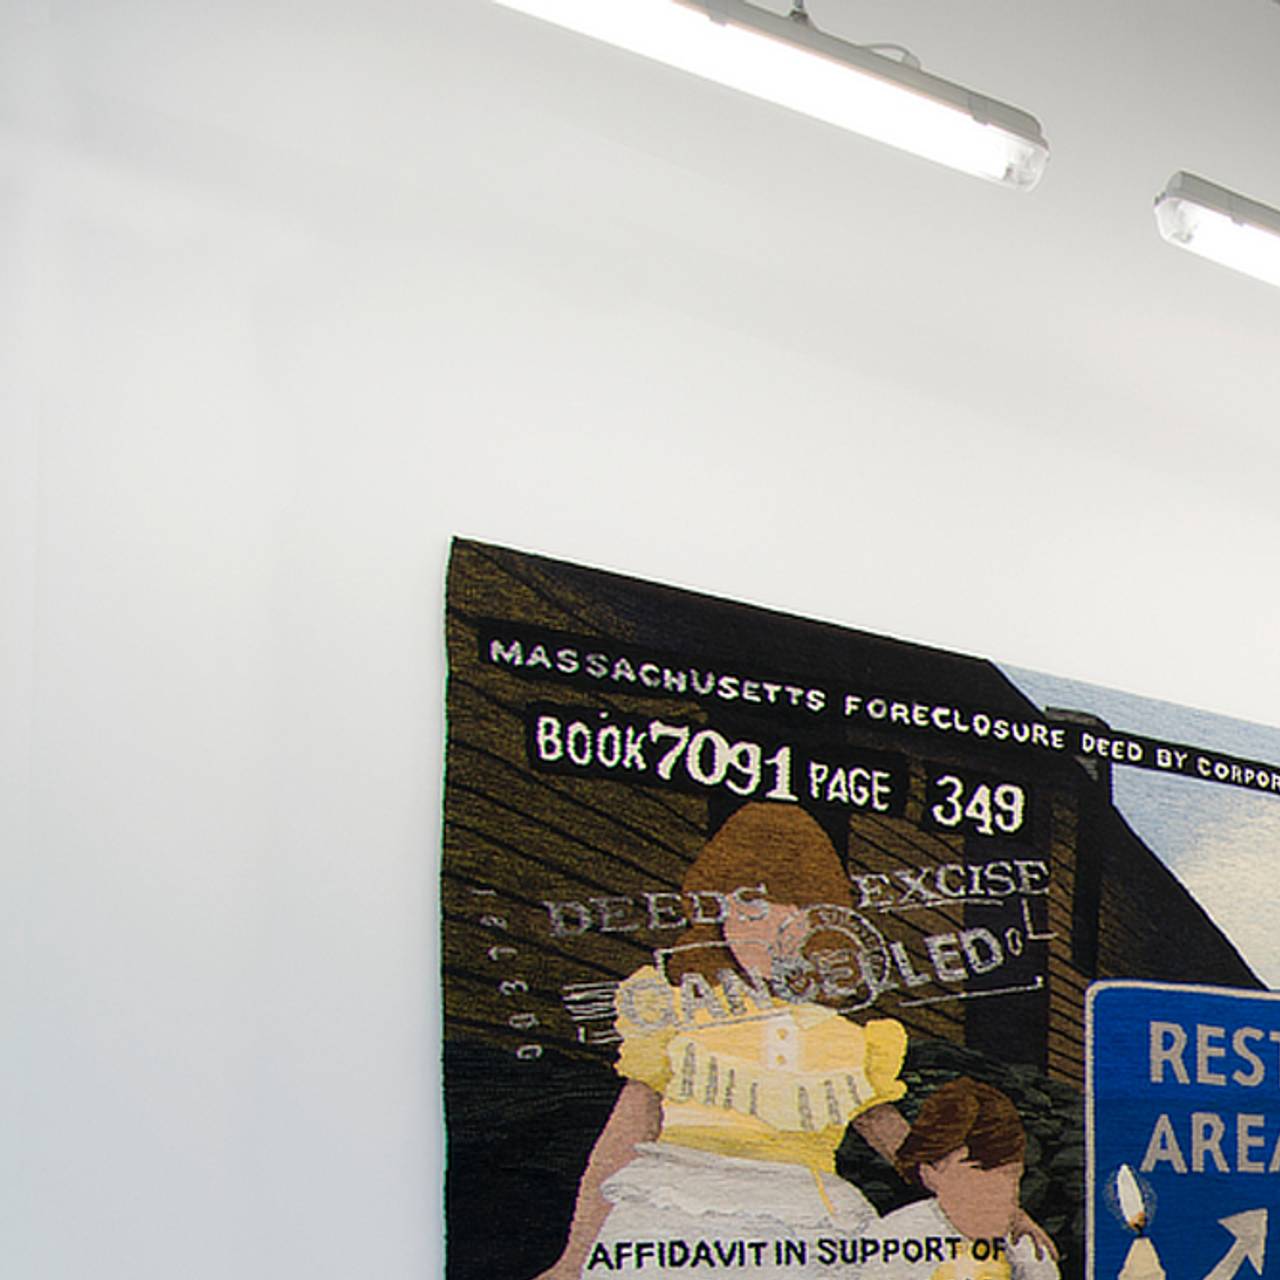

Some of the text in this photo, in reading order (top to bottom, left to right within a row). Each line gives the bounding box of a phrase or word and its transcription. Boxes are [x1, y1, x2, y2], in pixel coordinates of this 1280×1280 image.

[490, 638, 828, 712] MASSACHUSETTS
[842, 694, 1066, 752] FORECLOSURE
[1081, 734, 1143, 762] DEED
[1156, 747, 1189, 769] BY
[536, 713, 1026, 836] BOOK 7091 PAGE 349
[849, 858, 1051, 910] EXCISE
[587, 1236, 1008, 1271] AFFIDAVIT IN SUPPORT OF
